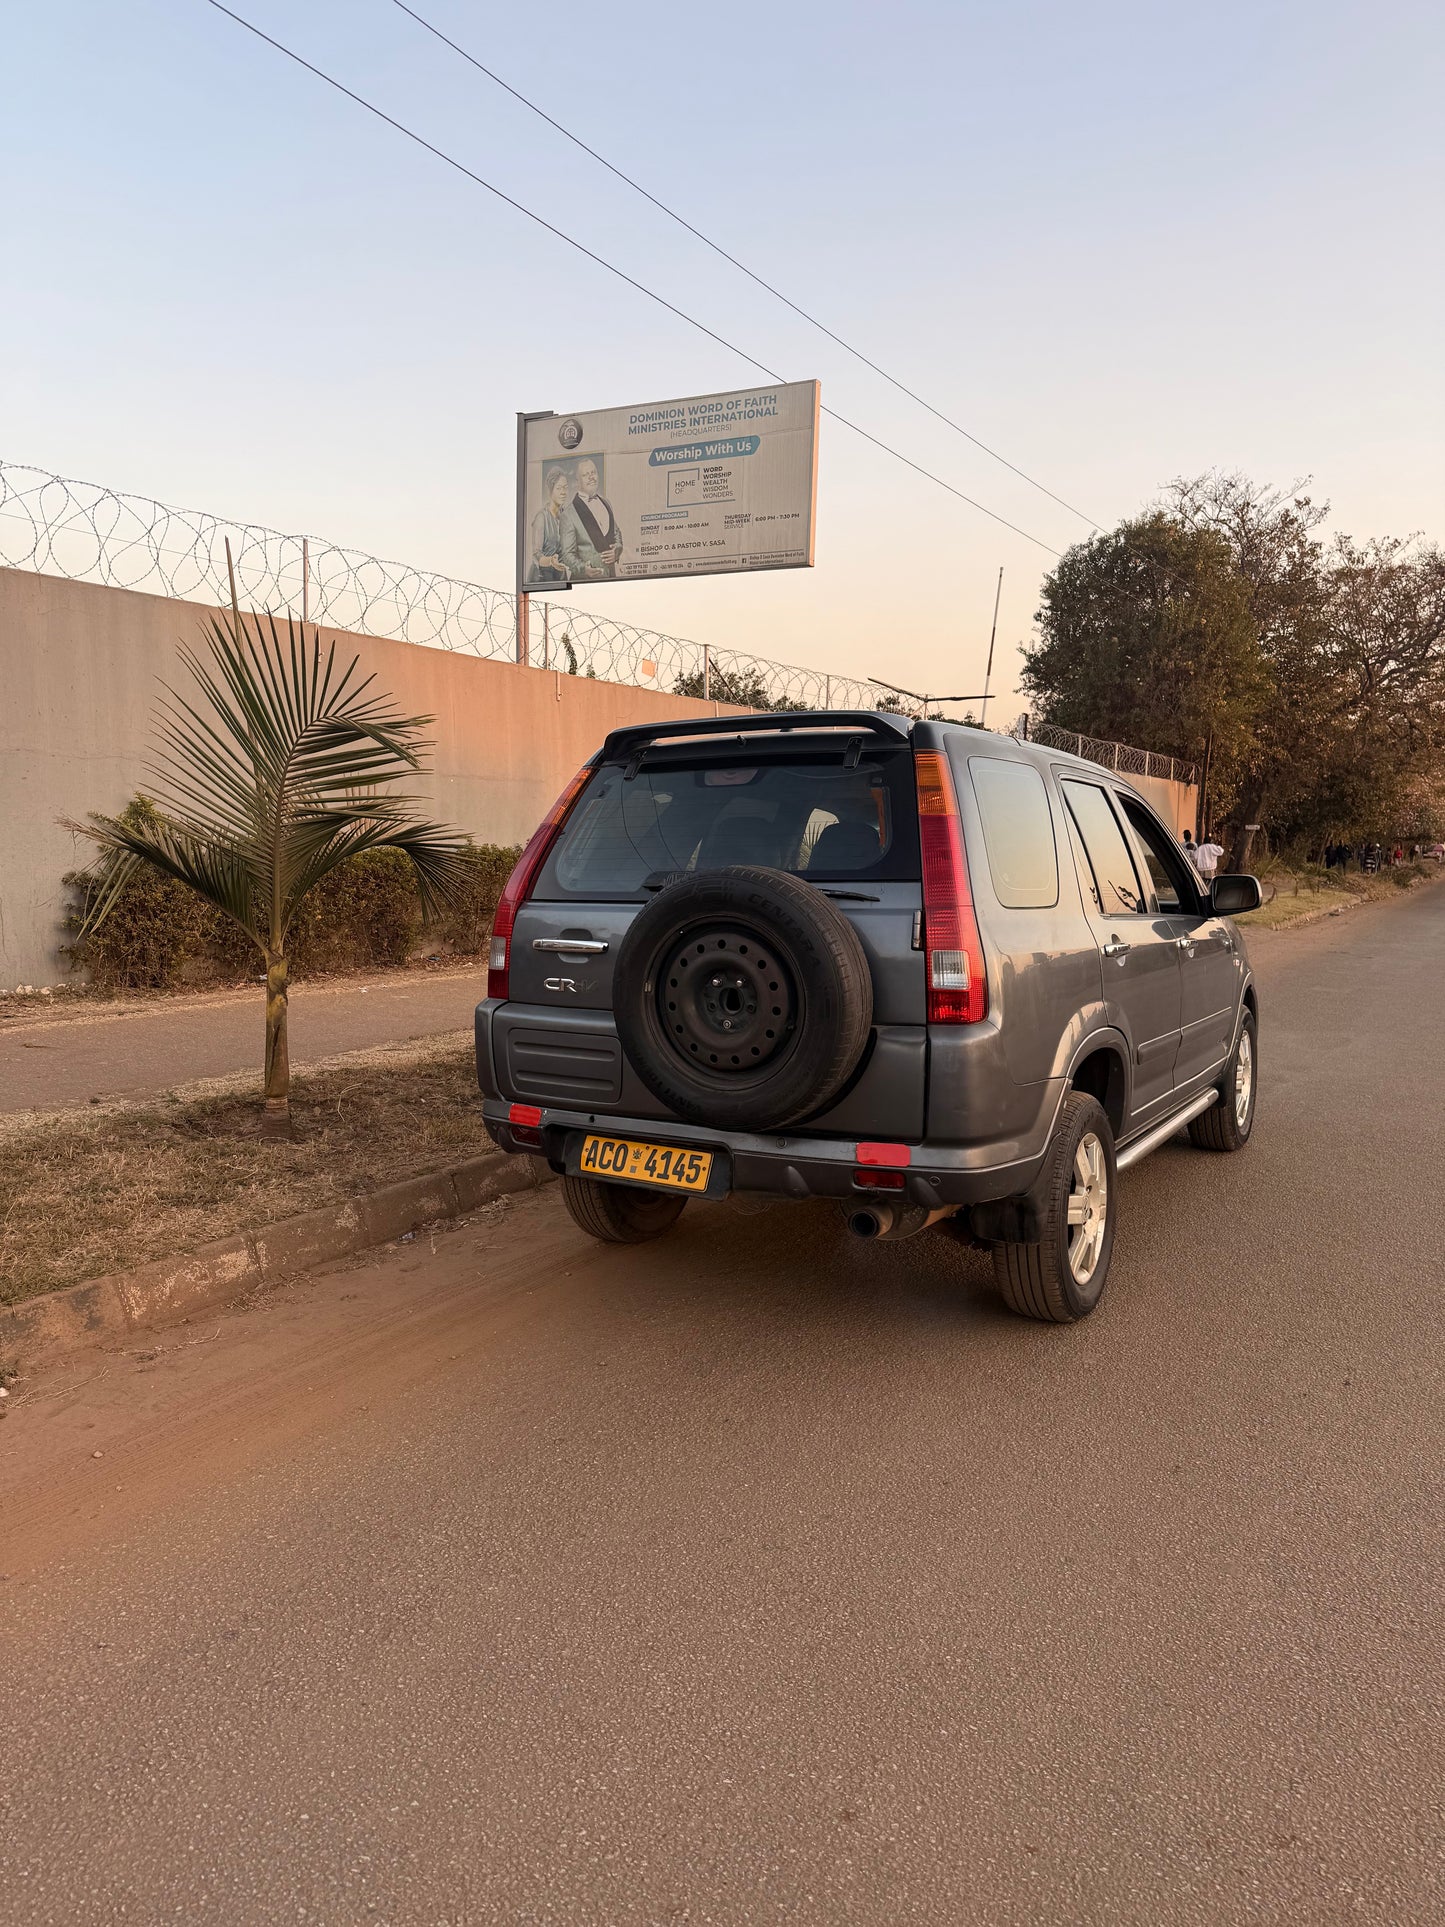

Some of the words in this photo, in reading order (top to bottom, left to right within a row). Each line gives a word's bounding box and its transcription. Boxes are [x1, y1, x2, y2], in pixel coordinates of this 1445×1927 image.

[629, 408, 685, 424] DOMINION
[688, 402, 723, 416] WORD
[726, 399, 742, 411] OF
[744, 394, 777, 408] FAITH
[628, 419, 687, 435] MINISTRIES
[689, 407, 779, 427] INTERNATIONAL
[654, 446, 702, 462] Worship
[705, 442, 734, 457] With
[736, 441, 752, 452] Us
[703, 471, 732, 480] WORSHIP
[675, 480, 696, 488] HOME
[702, 478, 728, 486] WEALTH
[674, 487, 684, 495] OF
[702, 485, 729, 493] WISDOM
[702, 491, 733, 499] WONDERS
[640, 545, 663, 553] BISHOP
[677, 542, 702, 550] PASTOR
[584, 1139, 629, 1173] ACO
[644, 1148, 703, 1184] 4145
